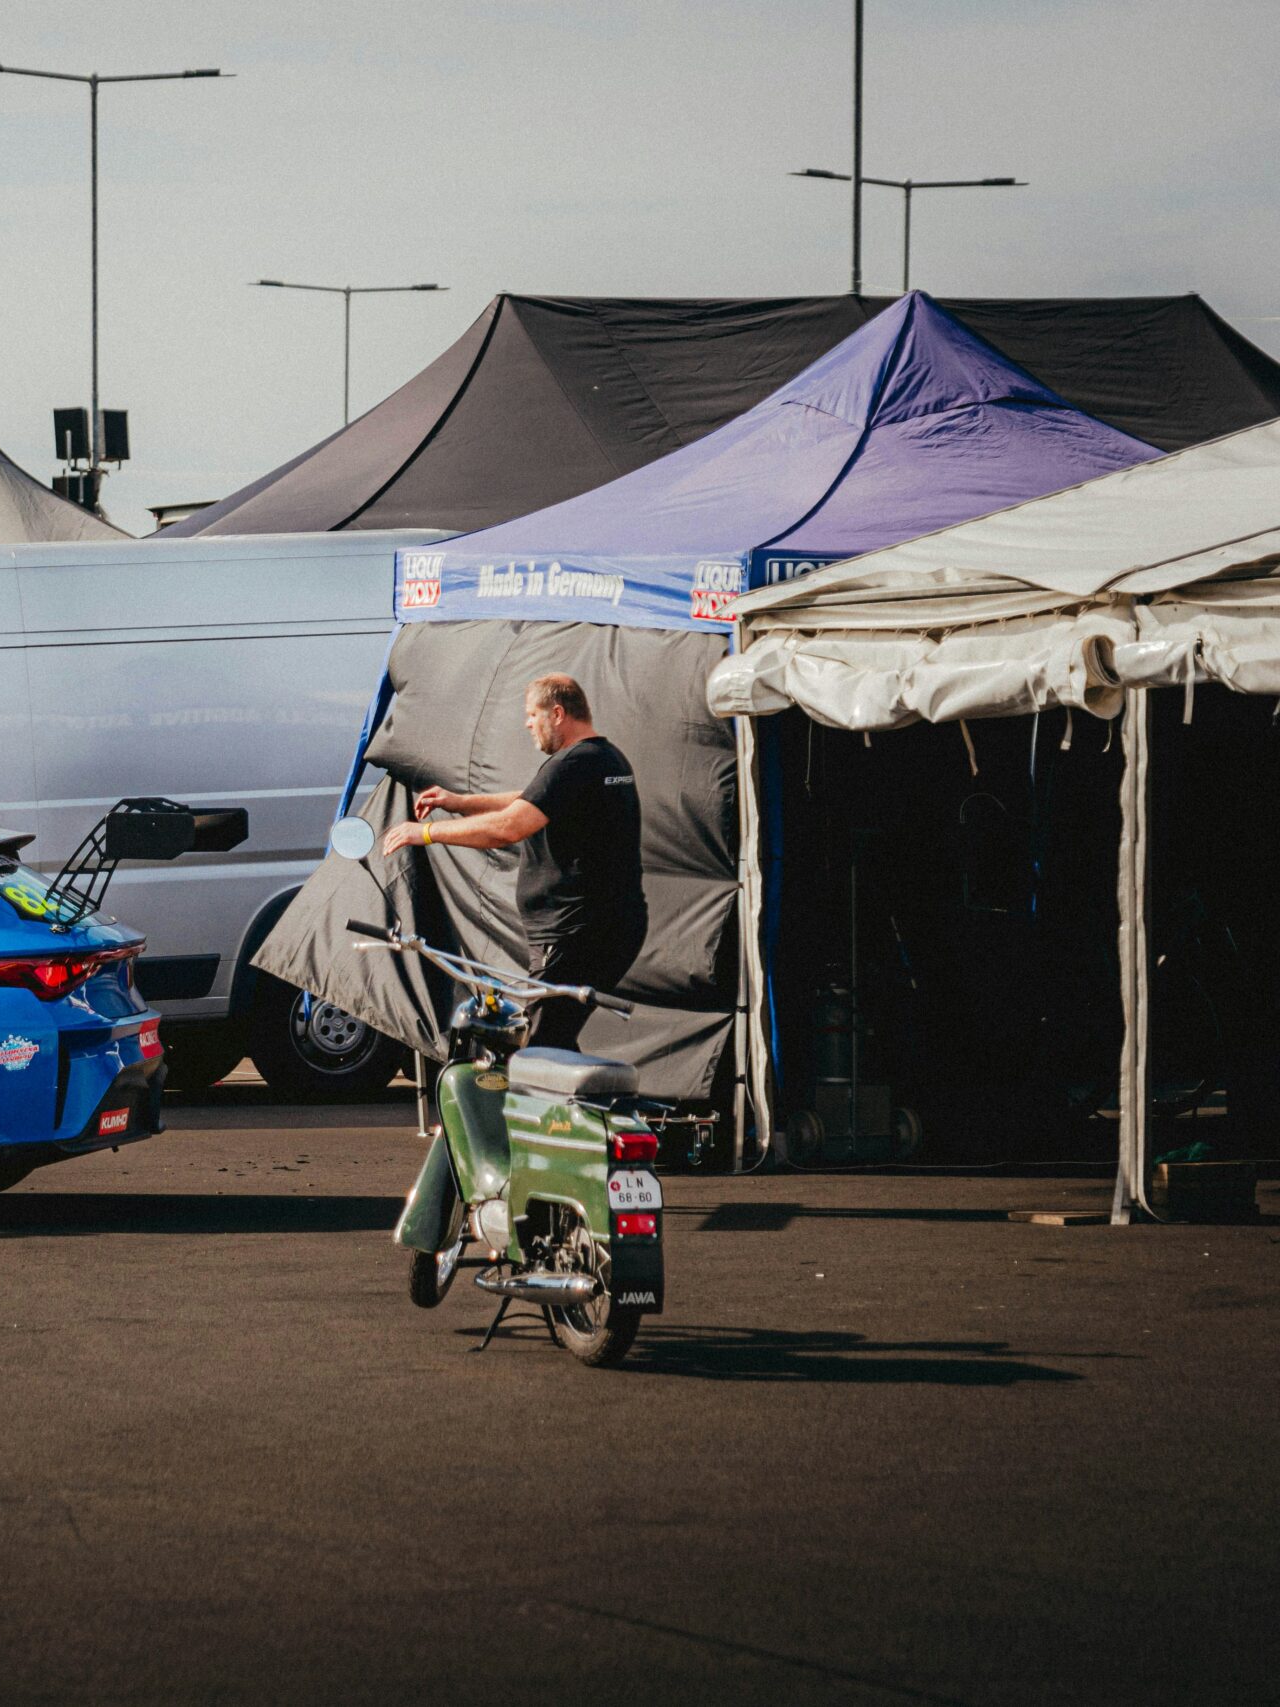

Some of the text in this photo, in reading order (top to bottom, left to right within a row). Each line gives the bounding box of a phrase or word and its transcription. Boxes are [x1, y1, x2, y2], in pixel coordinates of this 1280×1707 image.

[405, 556, 442, 579] LIQUI
[403, 581, 440, 606] MOLY
[477, 561, 625, 607] Made in Germany
[101, 1113, 129, 1130] KUMHO
[618, 1291, 656, 1304] JAWA
